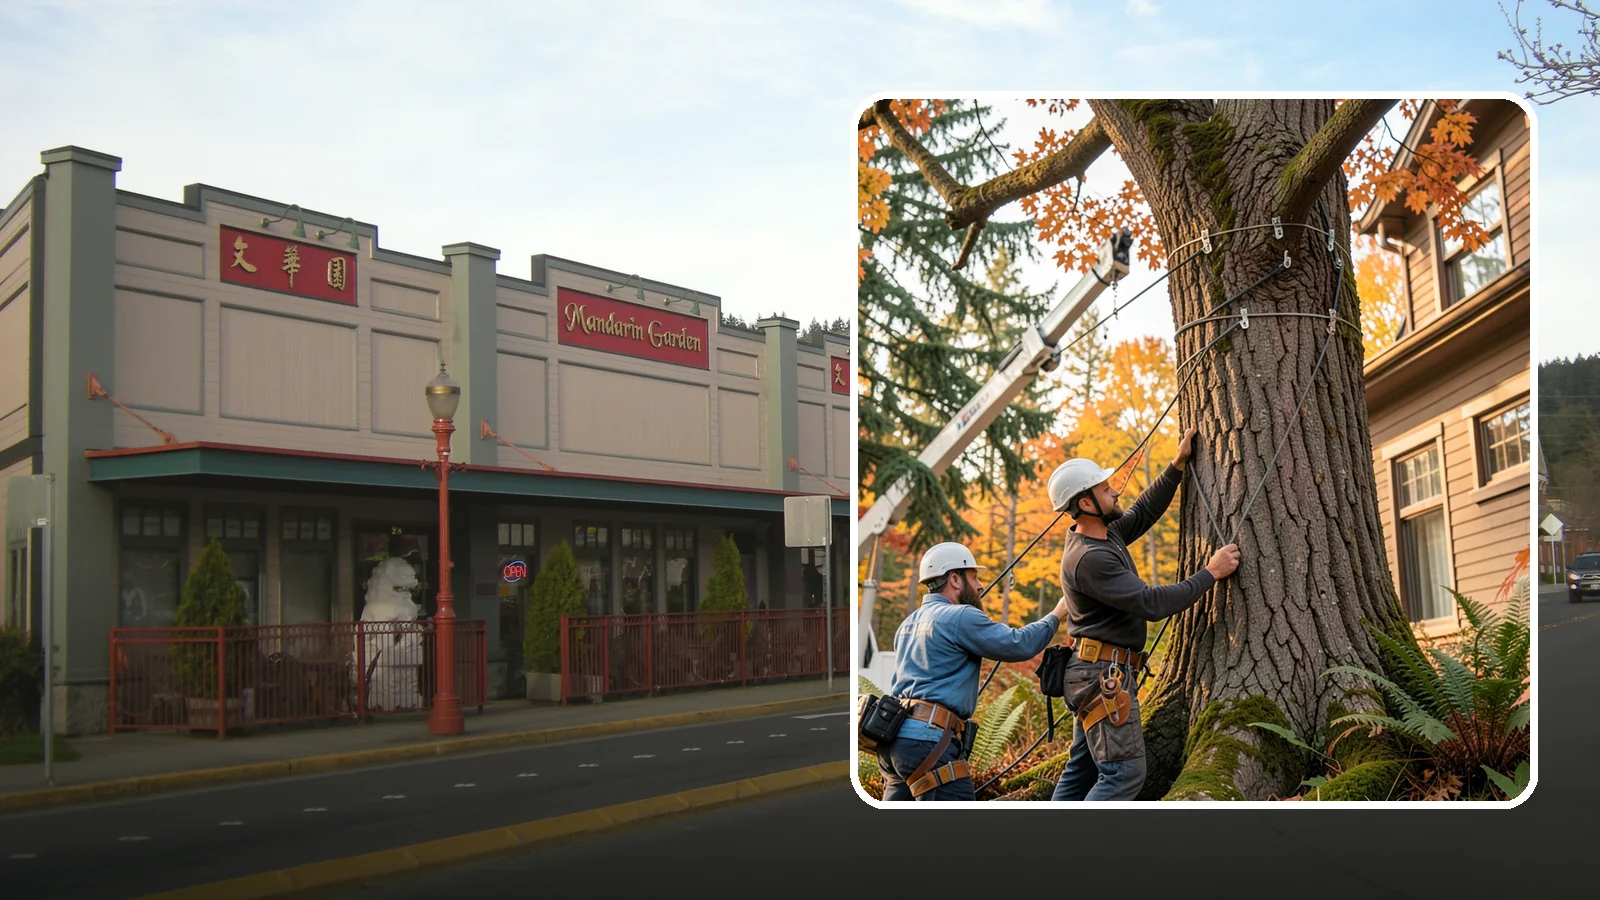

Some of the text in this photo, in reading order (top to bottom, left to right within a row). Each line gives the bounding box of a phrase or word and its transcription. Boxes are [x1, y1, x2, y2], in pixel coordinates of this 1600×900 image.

[230, 235, 346, 291] 文華園
[564, 302, 702, 352] Mandarin Garden
[835, 363, 846, 386] 文
[503, 565, 527, 578] OPEN
